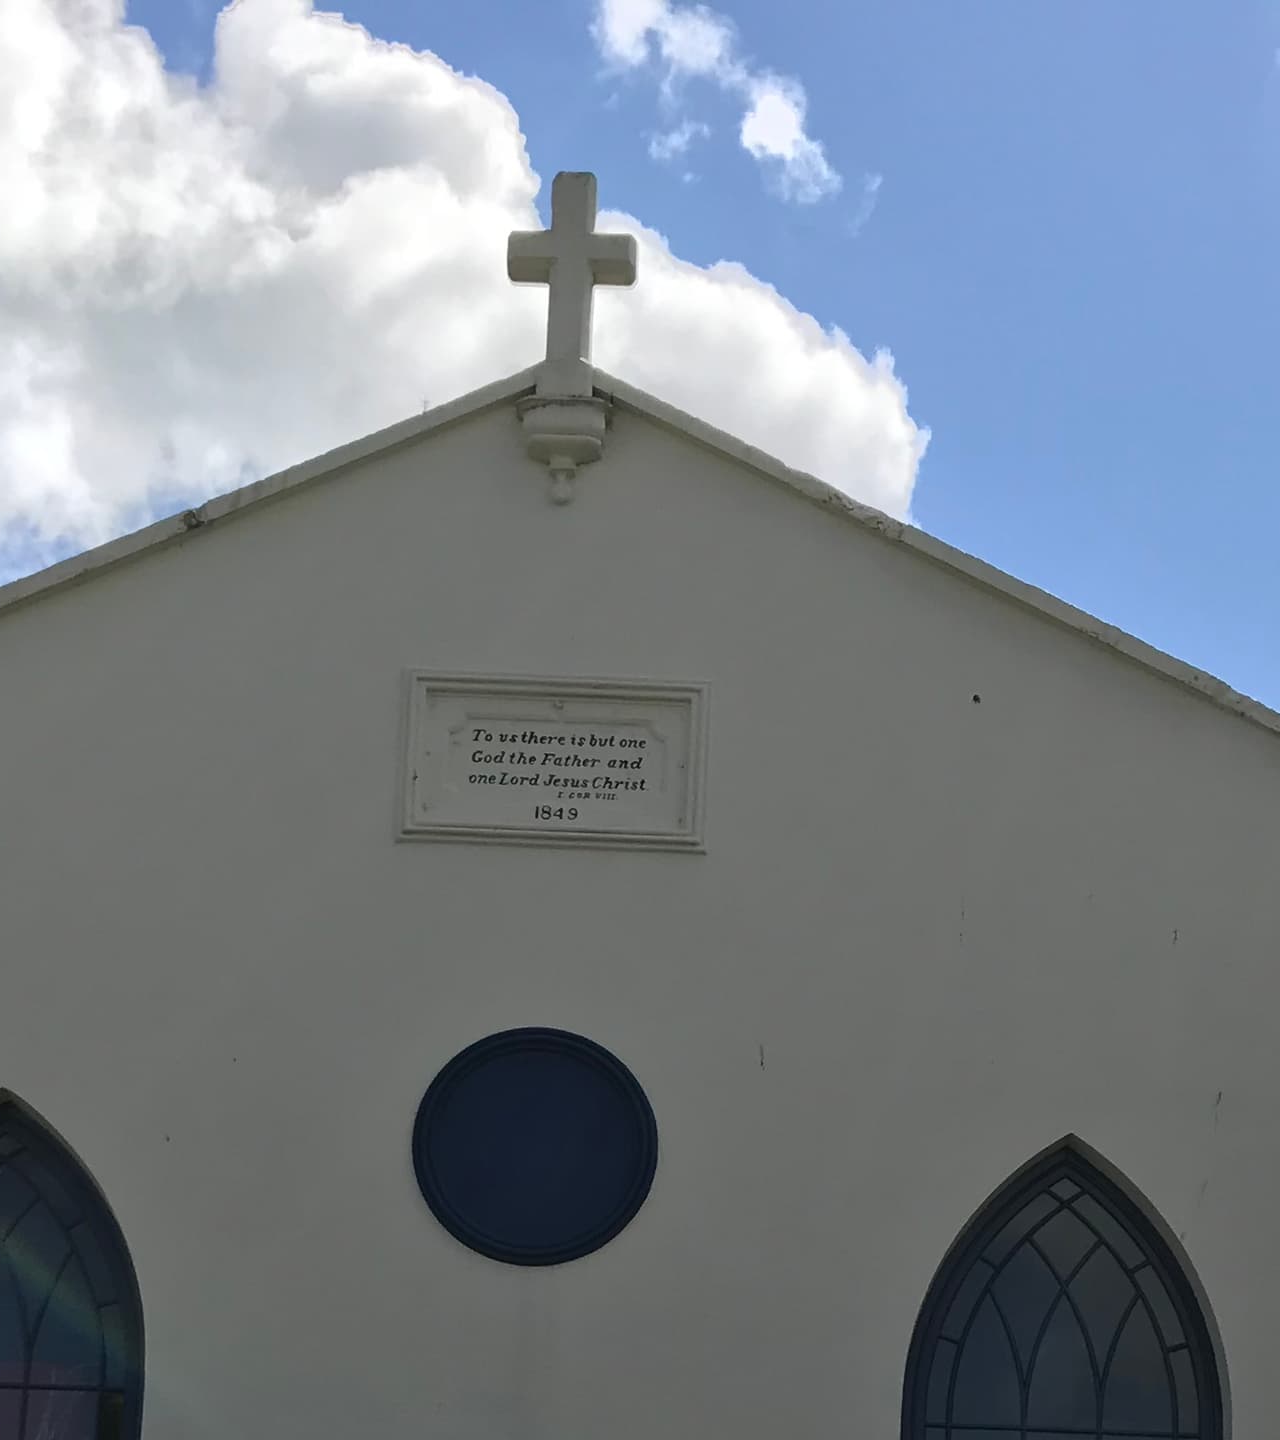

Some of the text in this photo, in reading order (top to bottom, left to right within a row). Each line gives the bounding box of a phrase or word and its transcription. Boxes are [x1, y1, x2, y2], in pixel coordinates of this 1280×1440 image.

[472, 729, 647, 749] To us there is but one
[471, 750, 643, 770] God the Father and
[468, 773, 496, 785] one
[498, 772, 540, 786] Lord
[543, 774, 589, 789] Jesus
[535, 805, 579, 821] 1849
